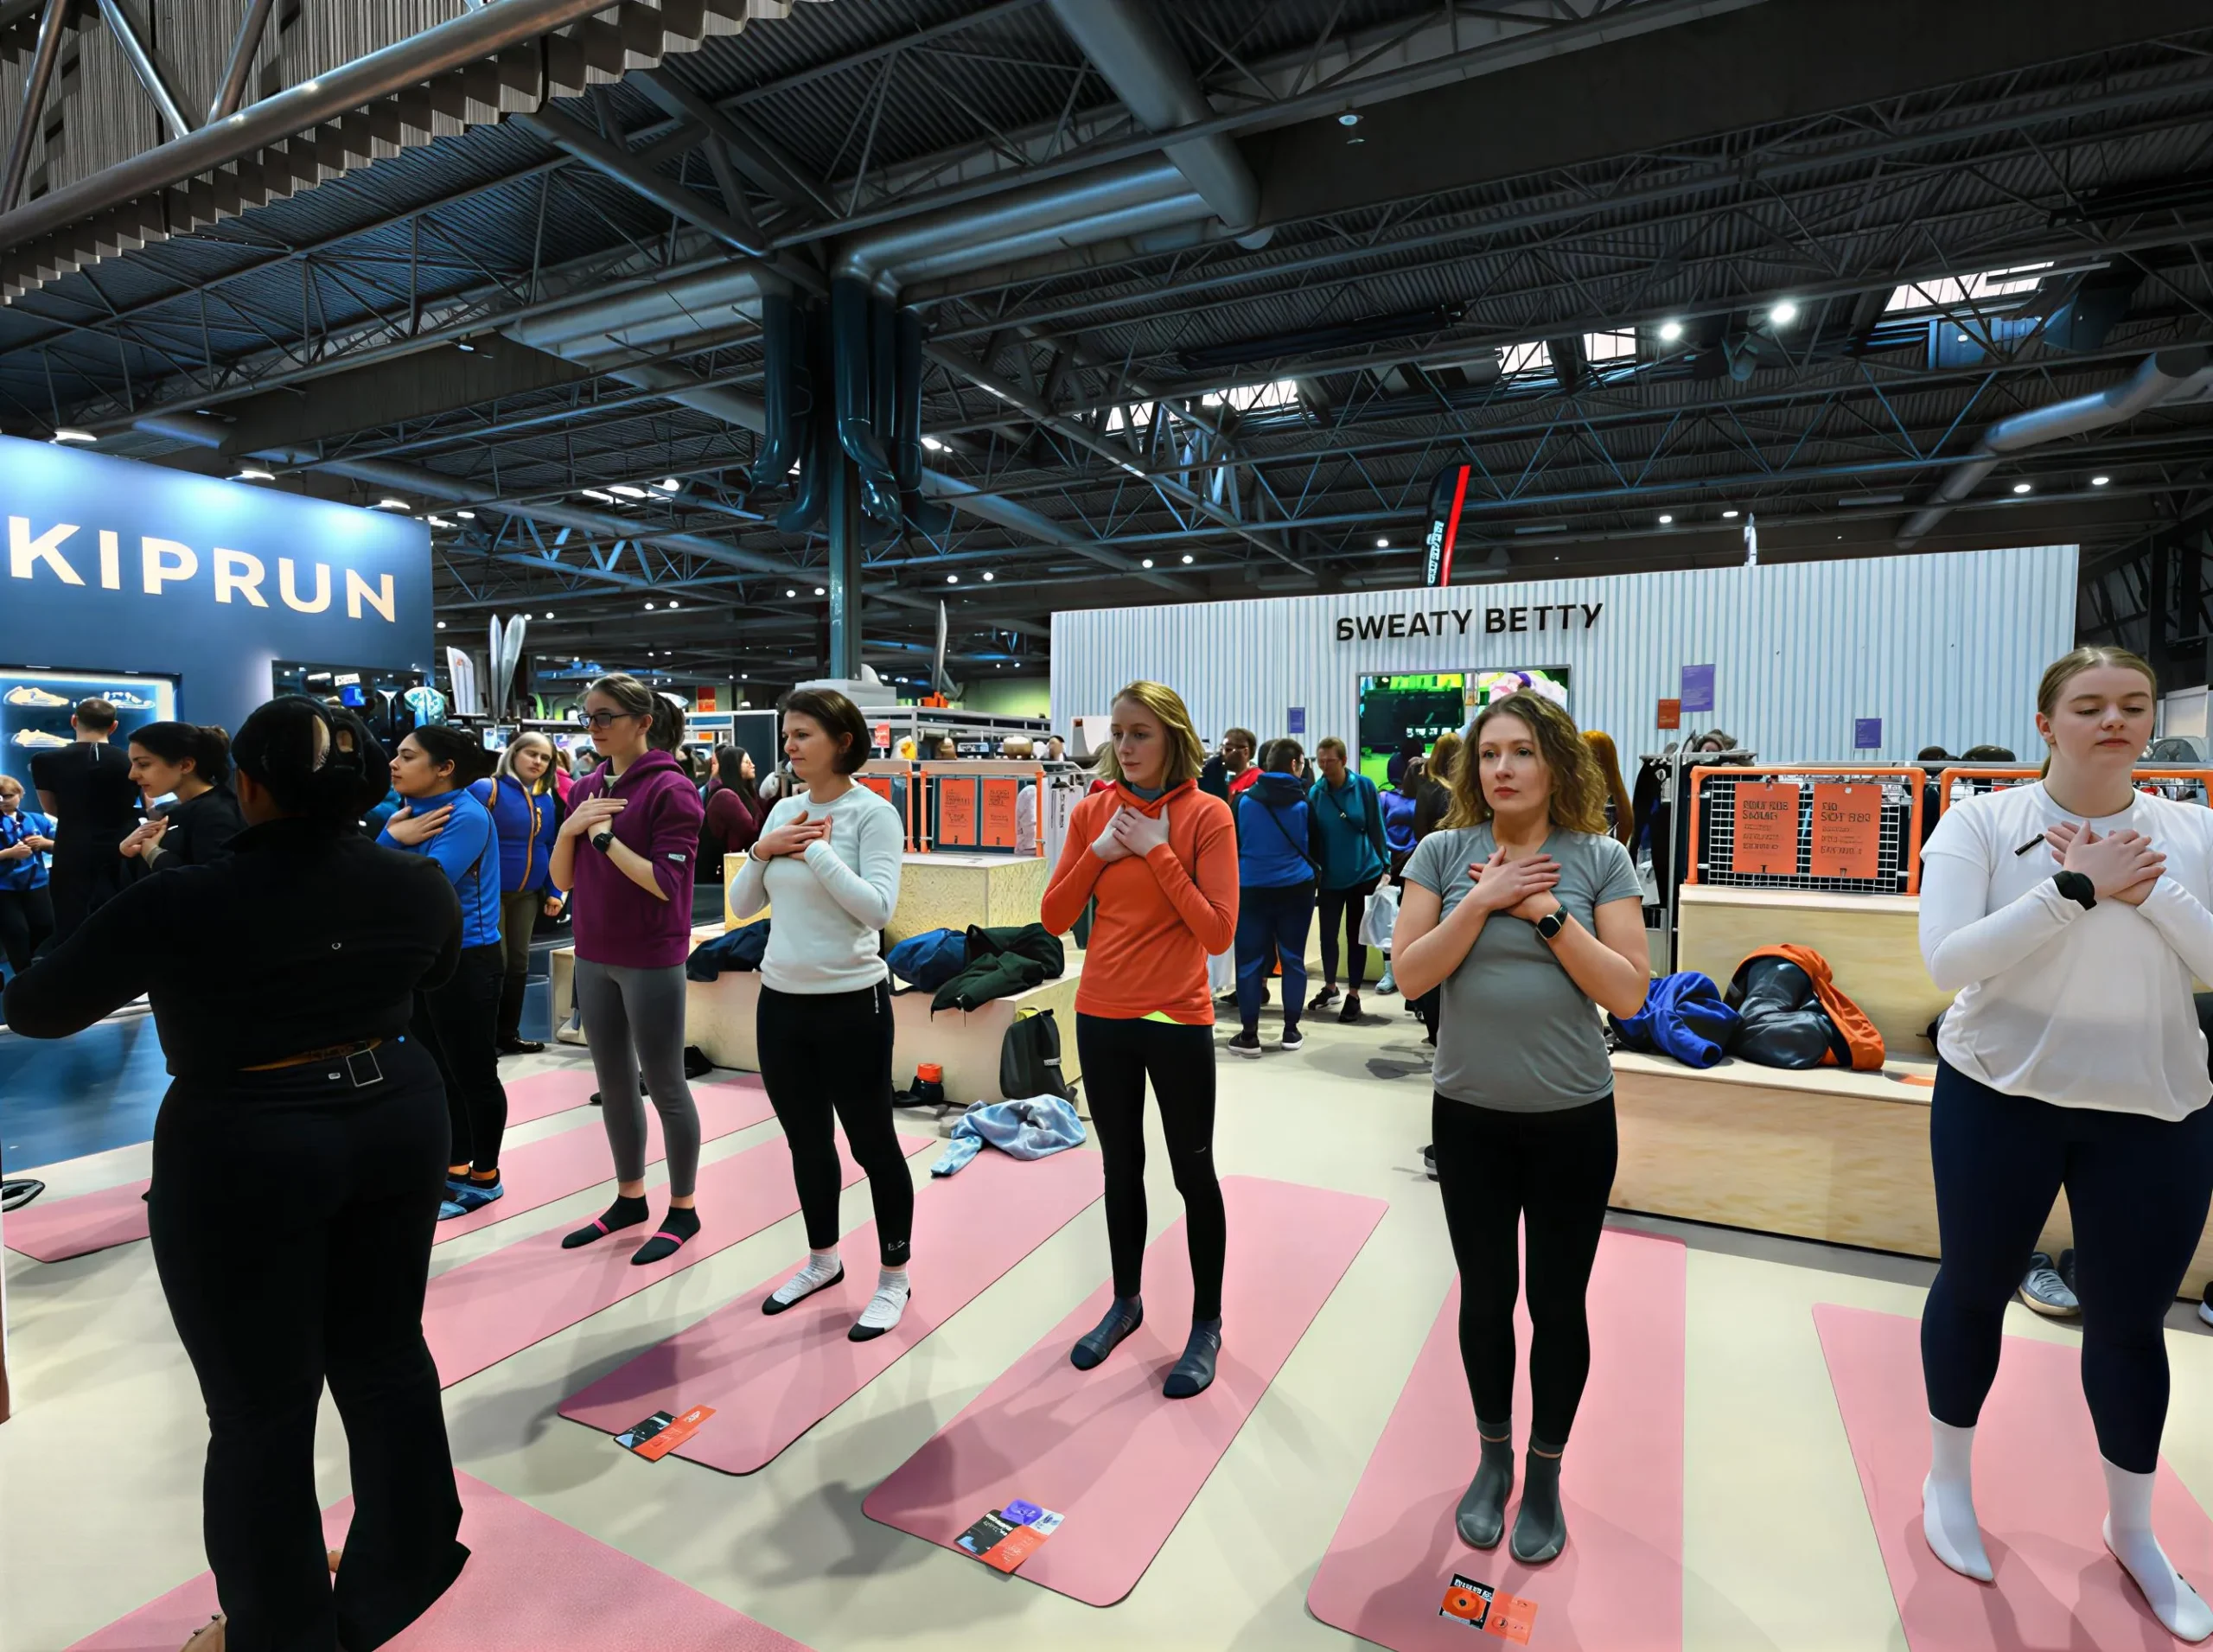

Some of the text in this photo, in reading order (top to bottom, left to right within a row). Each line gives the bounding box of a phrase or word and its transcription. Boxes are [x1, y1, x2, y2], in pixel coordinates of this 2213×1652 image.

[9, 516, 395, 622] KIPRUN
[1336, 603, 1604, 641] SWEATY BETTY
